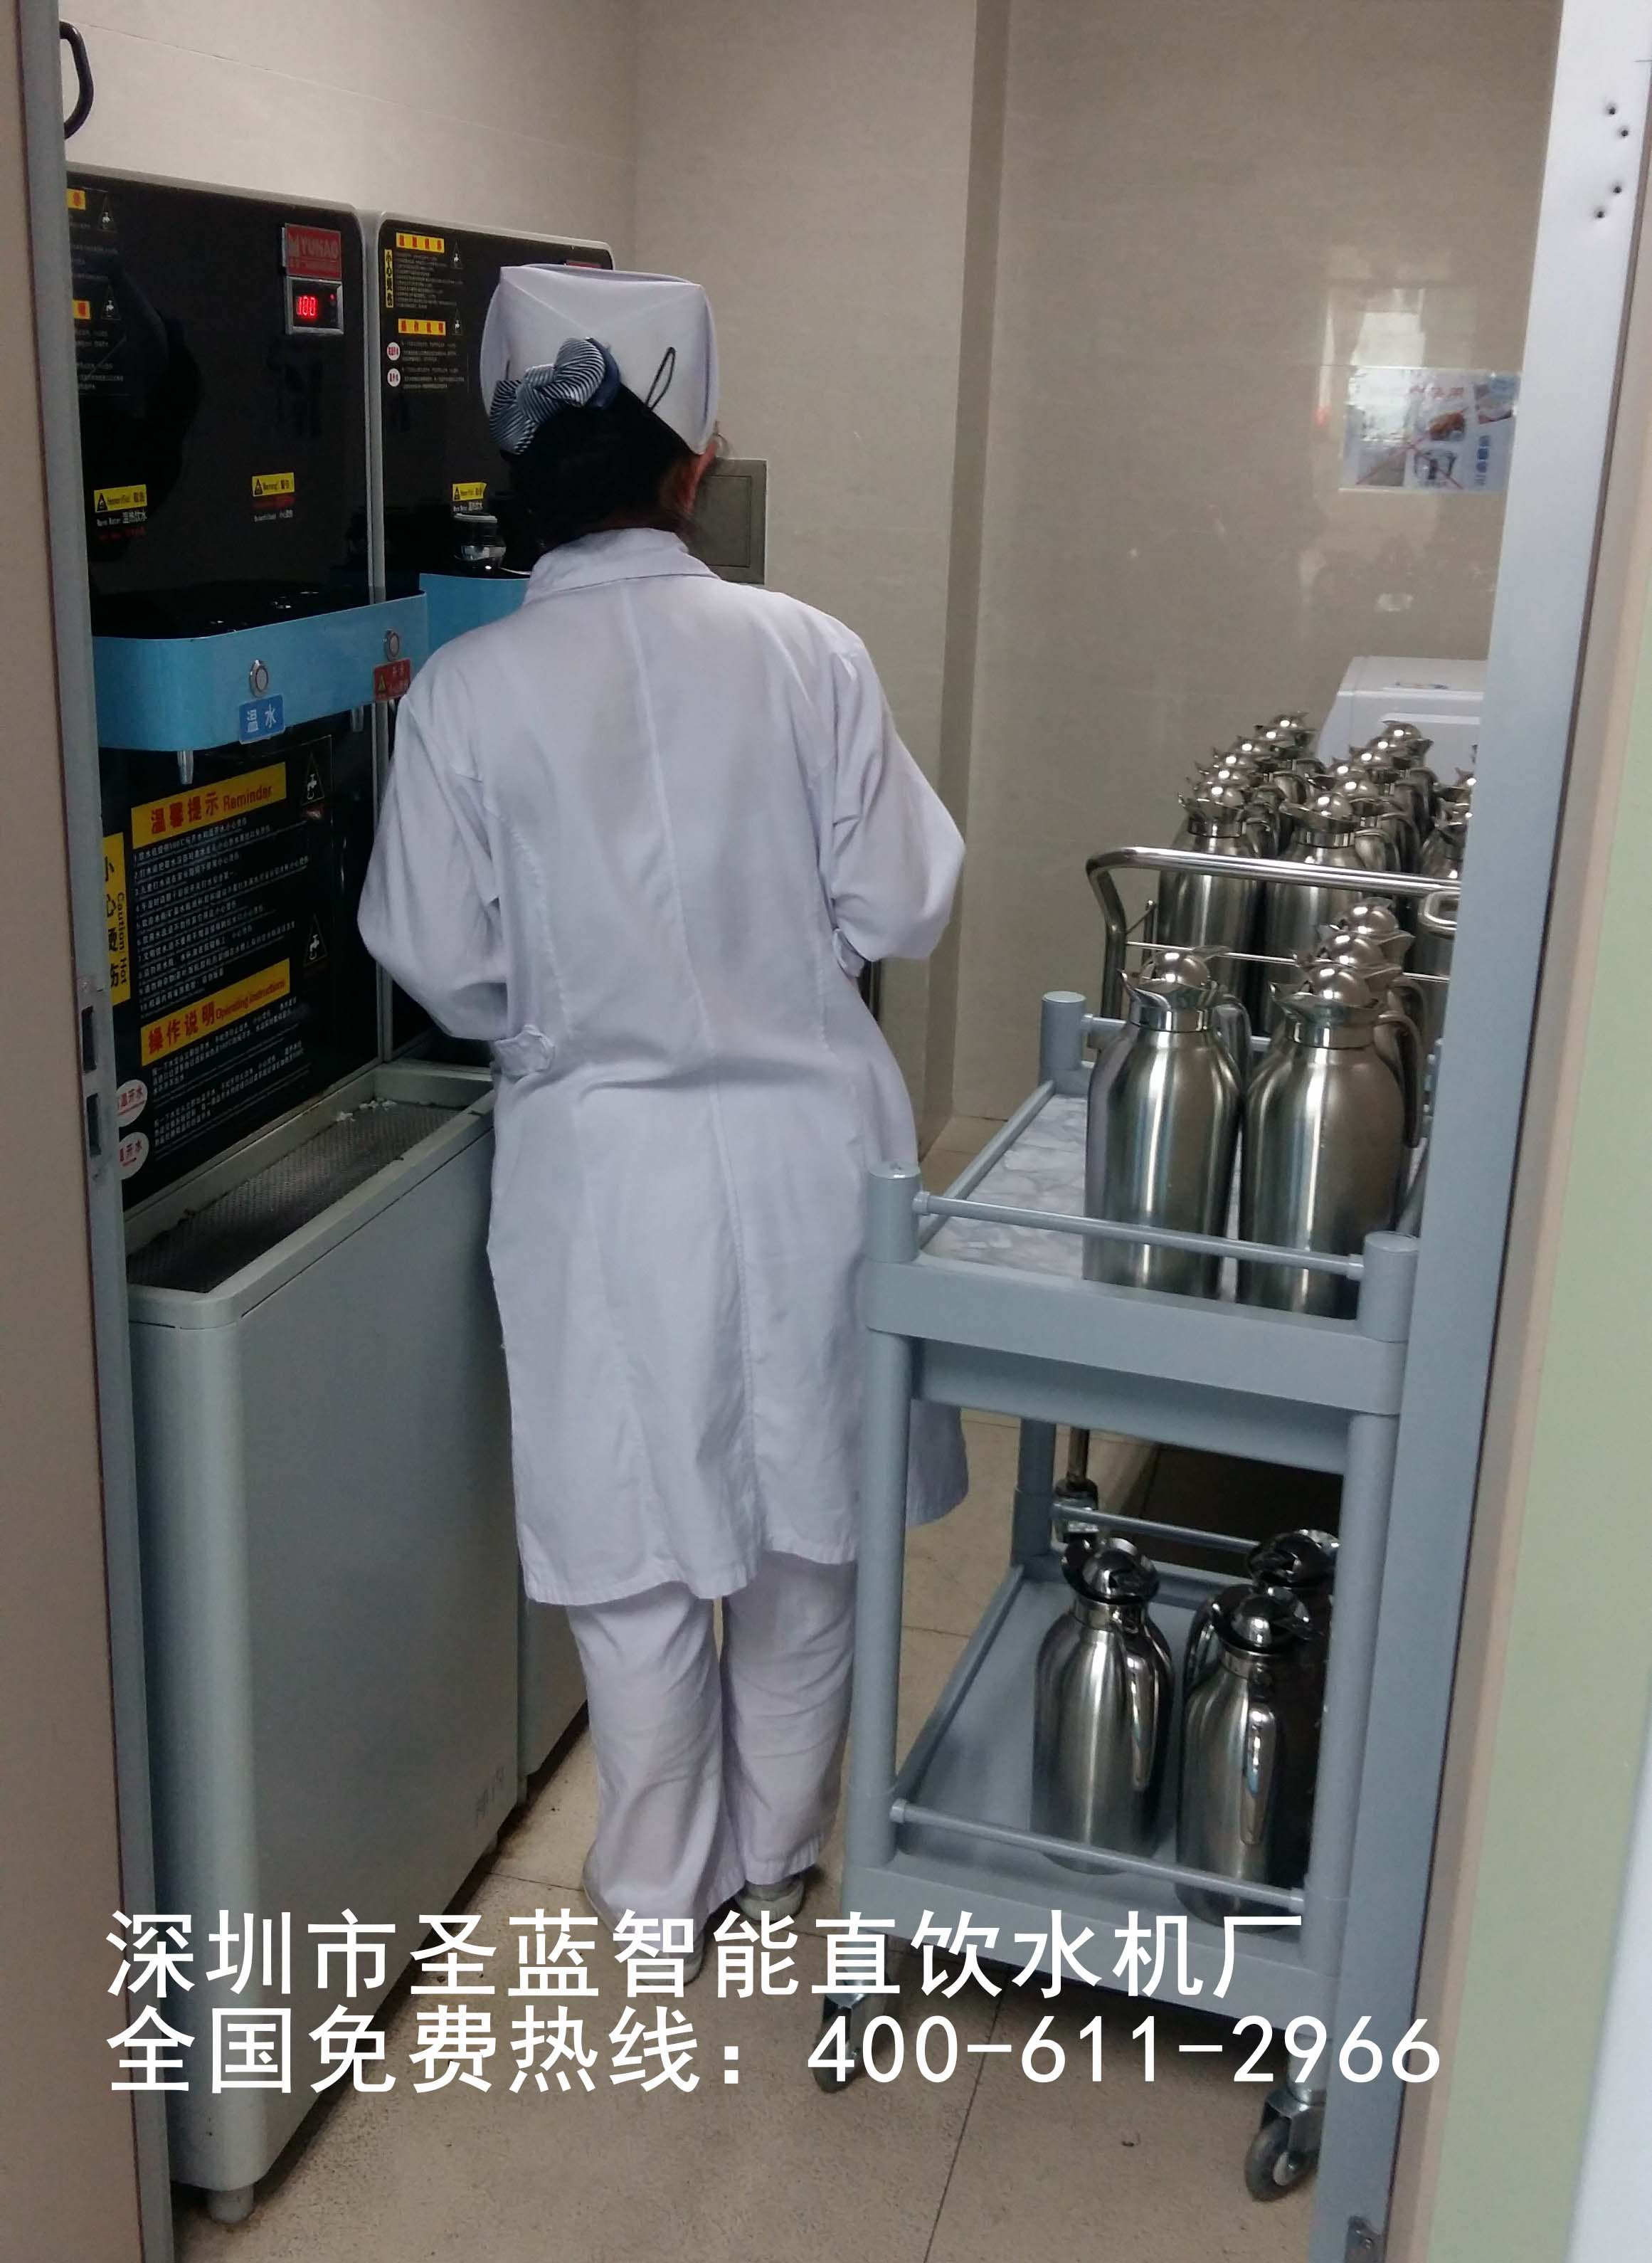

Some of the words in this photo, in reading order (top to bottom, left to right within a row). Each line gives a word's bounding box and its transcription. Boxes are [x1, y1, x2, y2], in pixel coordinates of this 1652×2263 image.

[297, 295, 316, 316] 100
[246, 703, 277, 733] 温水
[152, 791, 219, 835] 温馨提示
[223, 785, 273, 812] Reminder
[148, 1001, 215, 1055] 操作说明
